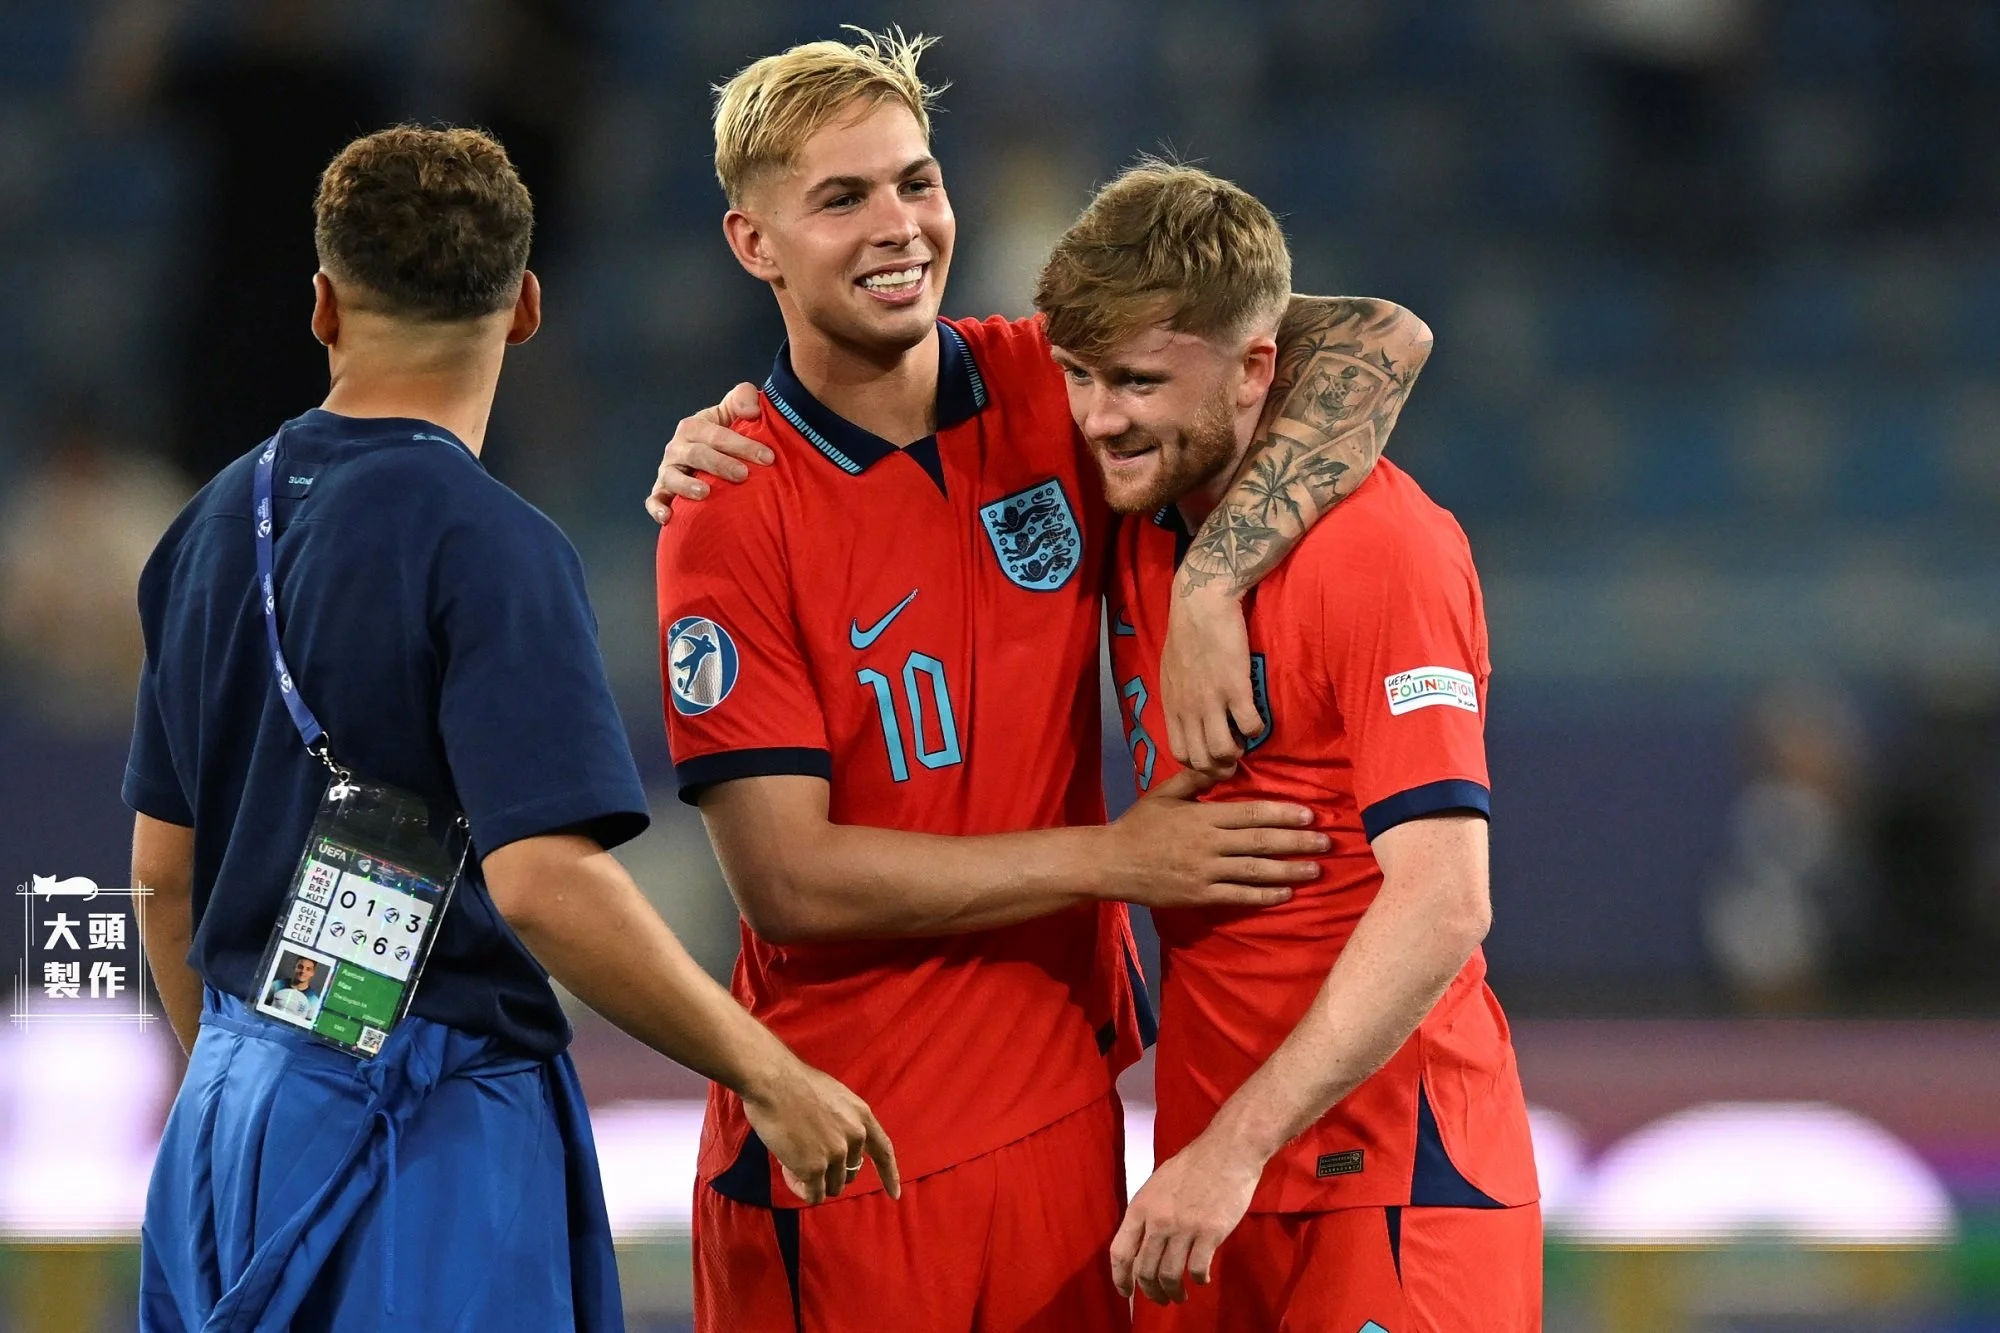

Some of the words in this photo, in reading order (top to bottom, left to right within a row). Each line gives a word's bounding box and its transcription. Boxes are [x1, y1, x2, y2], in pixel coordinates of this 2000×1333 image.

[1388, 673, 1412, 687] UEFA
[1390, 678, 1475, 701] FOUNDATION
[856, 650, 963, 783] 10
[318, 843, 347, 862] UEFA
[311, 875, 331, 888] MES
[308, 883, 328, 896] BAT
[306, 891, 325, 904] KUT
[297, 914, 316, 927] STE
[293, 923, 313, 936] CFR
[290, 931, 310, 943] CLU
[373, 937, 388, 955] 6
